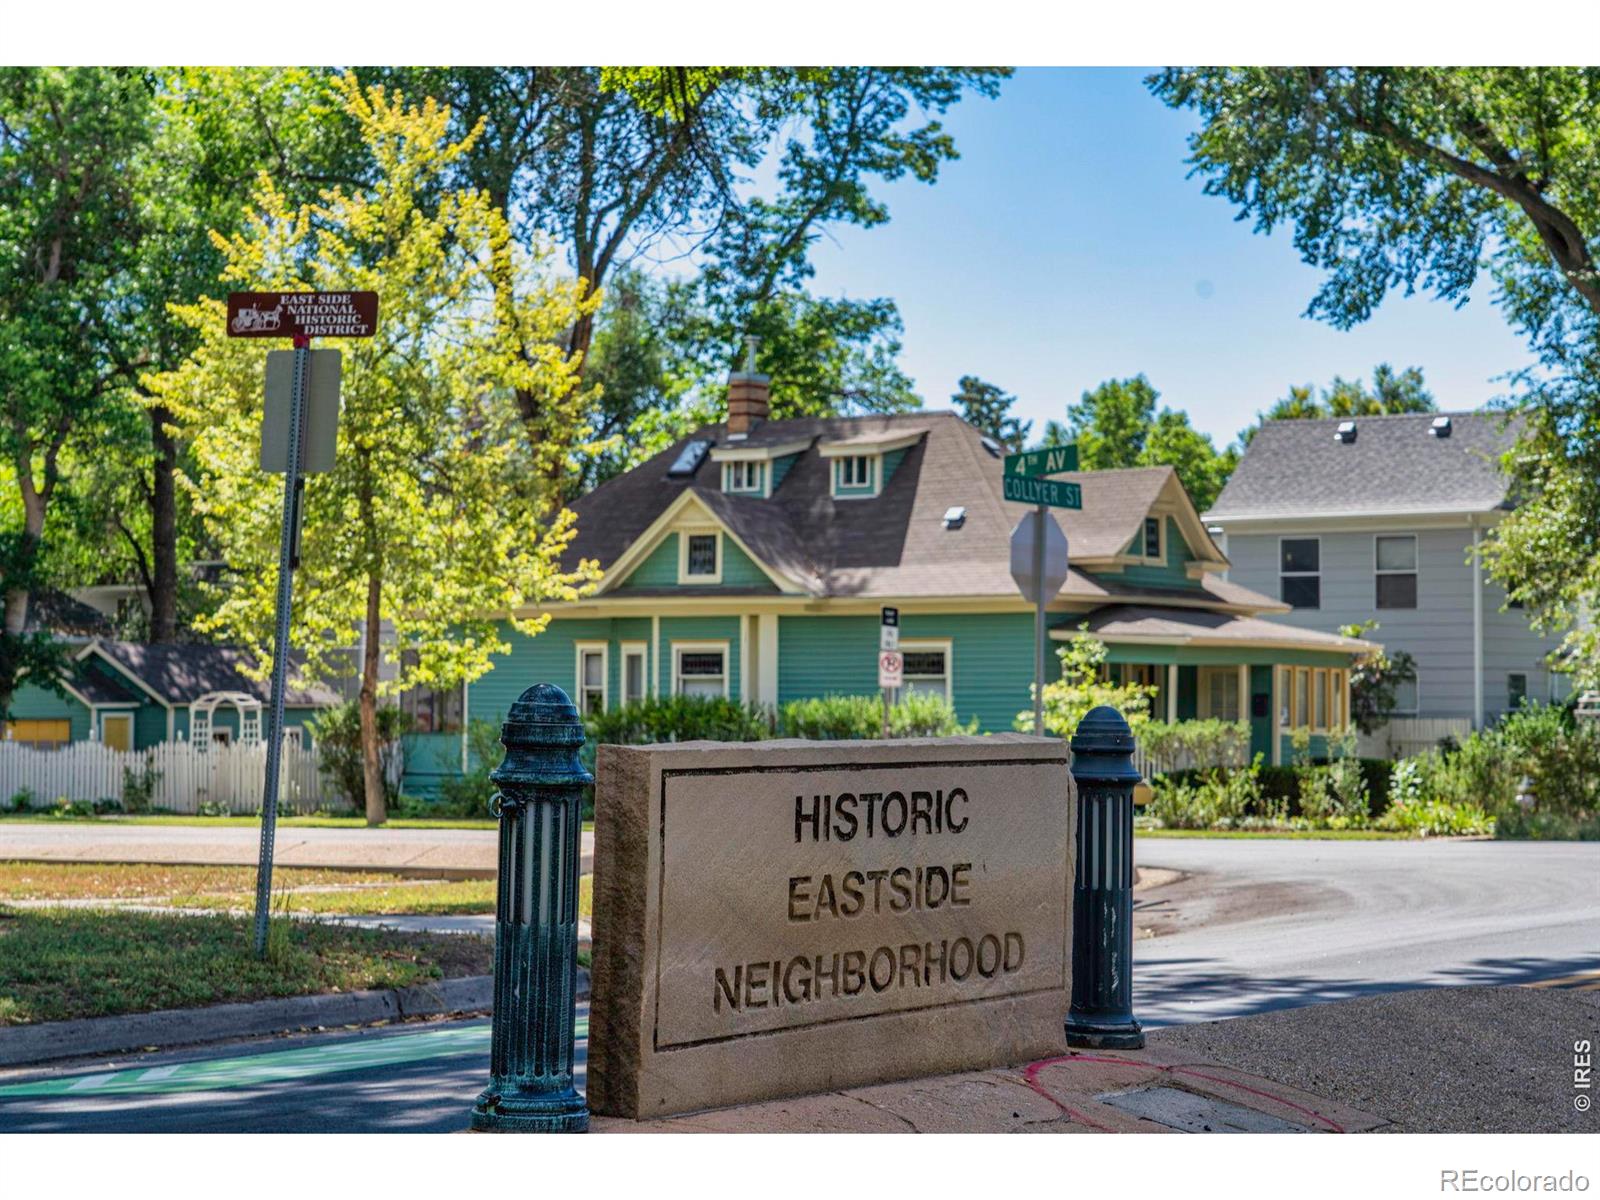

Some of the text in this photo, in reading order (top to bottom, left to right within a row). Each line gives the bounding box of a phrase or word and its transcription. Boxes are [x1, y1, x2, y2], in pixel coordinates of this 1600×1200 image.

[280, 294, 352, 305] EAST SIDE
[287, 304, 357, 315] NATIONAL
[294, 314, 362, 325] HISTORIC
[304, 324, 369, 335] DISTRICT
[1045, 449, 1066, 473] AV
[1005, 478, 1080, 507] COLLYER ST
[794, 787, 970, 843] HISTORIC
[787, 862, 973, 922] EASTSIDE
[713, 932, 1025, 1015] NEIGHBORHOOD
